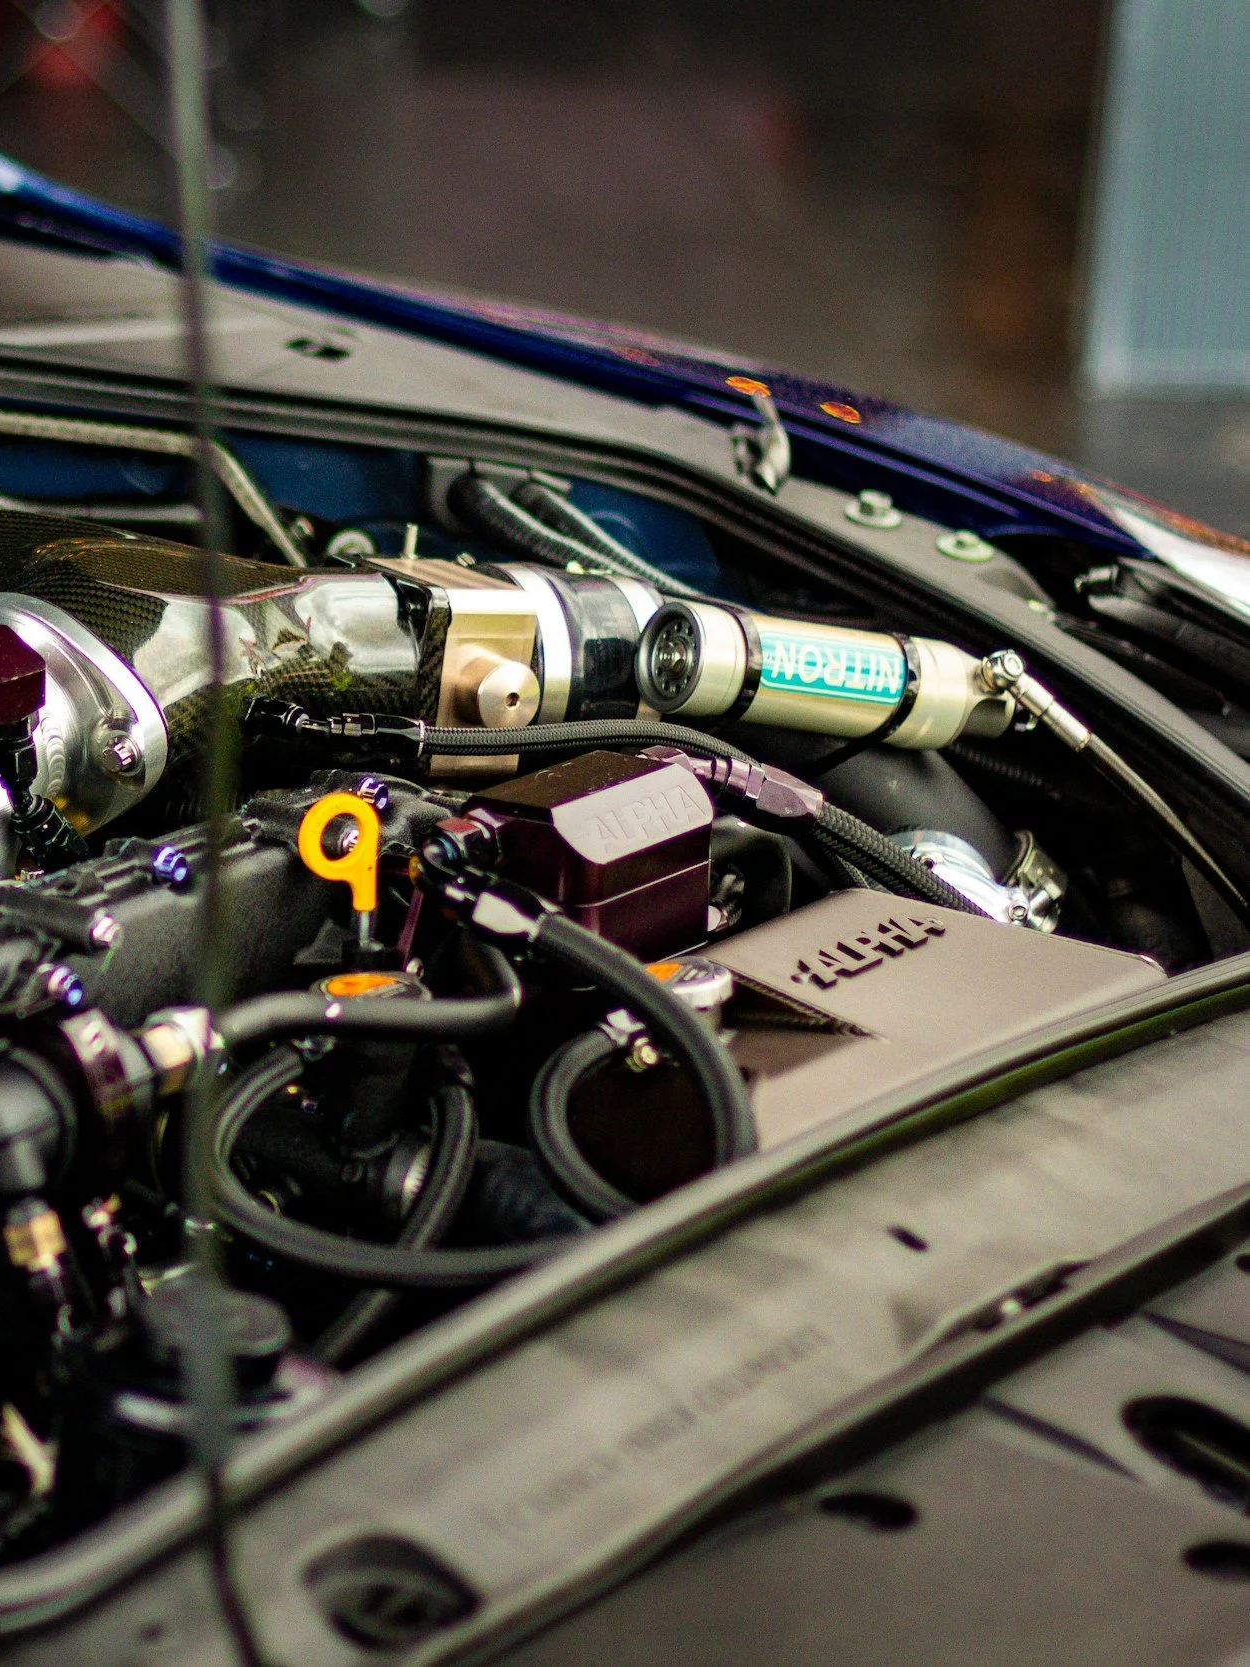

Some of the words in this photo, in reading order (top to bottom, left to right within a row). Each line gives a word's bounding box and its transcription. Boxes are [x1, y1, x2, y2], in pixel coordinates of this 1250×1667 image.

[770, 640, 900, 695] NITRON
[582, 784, 708, 854] ALPHA
[796, 917, 946, 990] ALPHA
